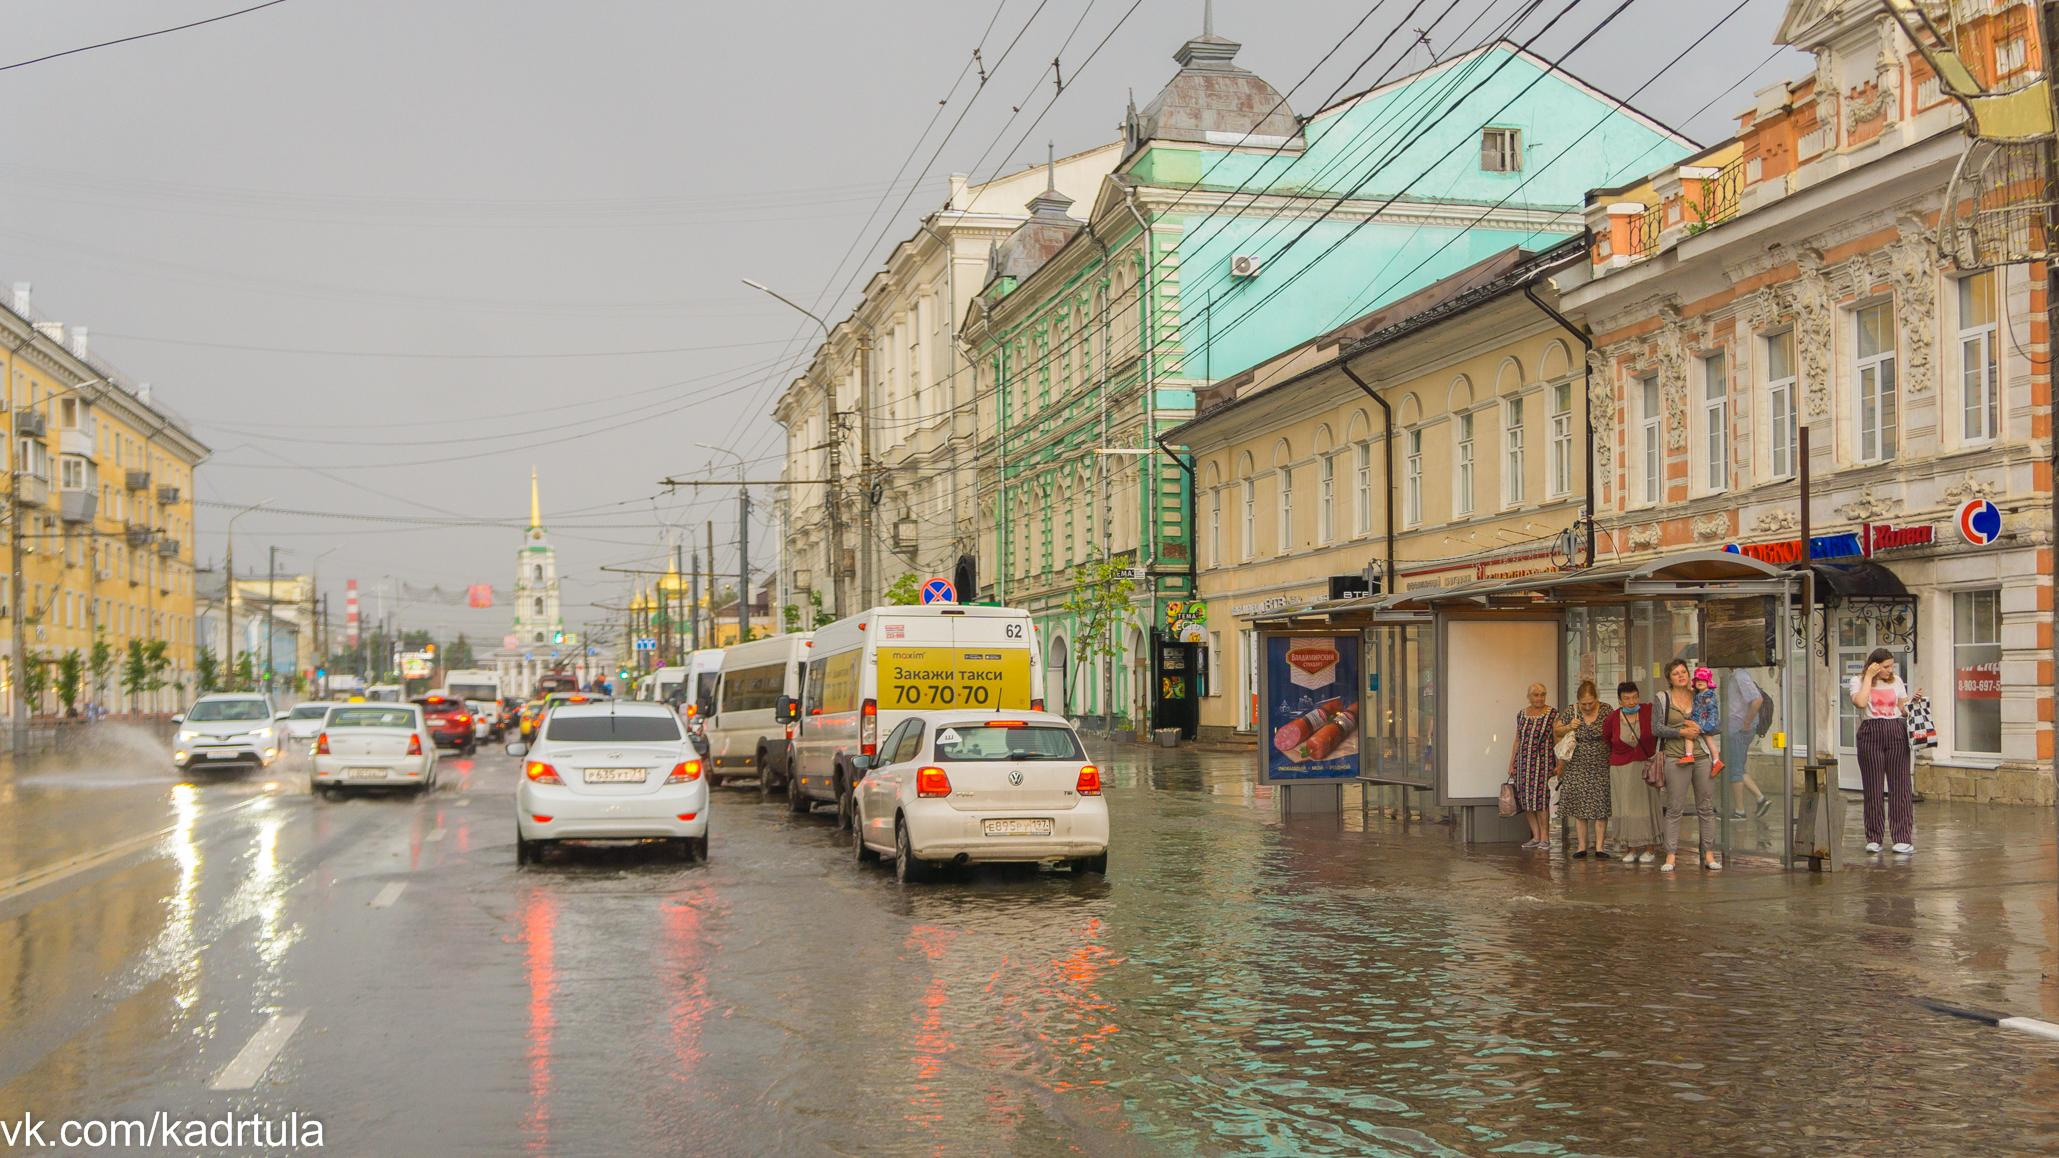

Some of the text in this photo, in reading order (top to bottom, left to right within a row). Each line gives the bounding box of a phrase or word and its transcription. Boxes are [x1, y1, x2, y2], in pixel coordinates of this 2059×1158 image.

[1874, 524, 1934, 549] Халва
[1006, 624, 1022, 638] 62
[1176, 621, 1200, 631] ЕСТЬ
[893, 651, 924, 659] maxim
[894, 666, 1003, 681] Закажи такси
